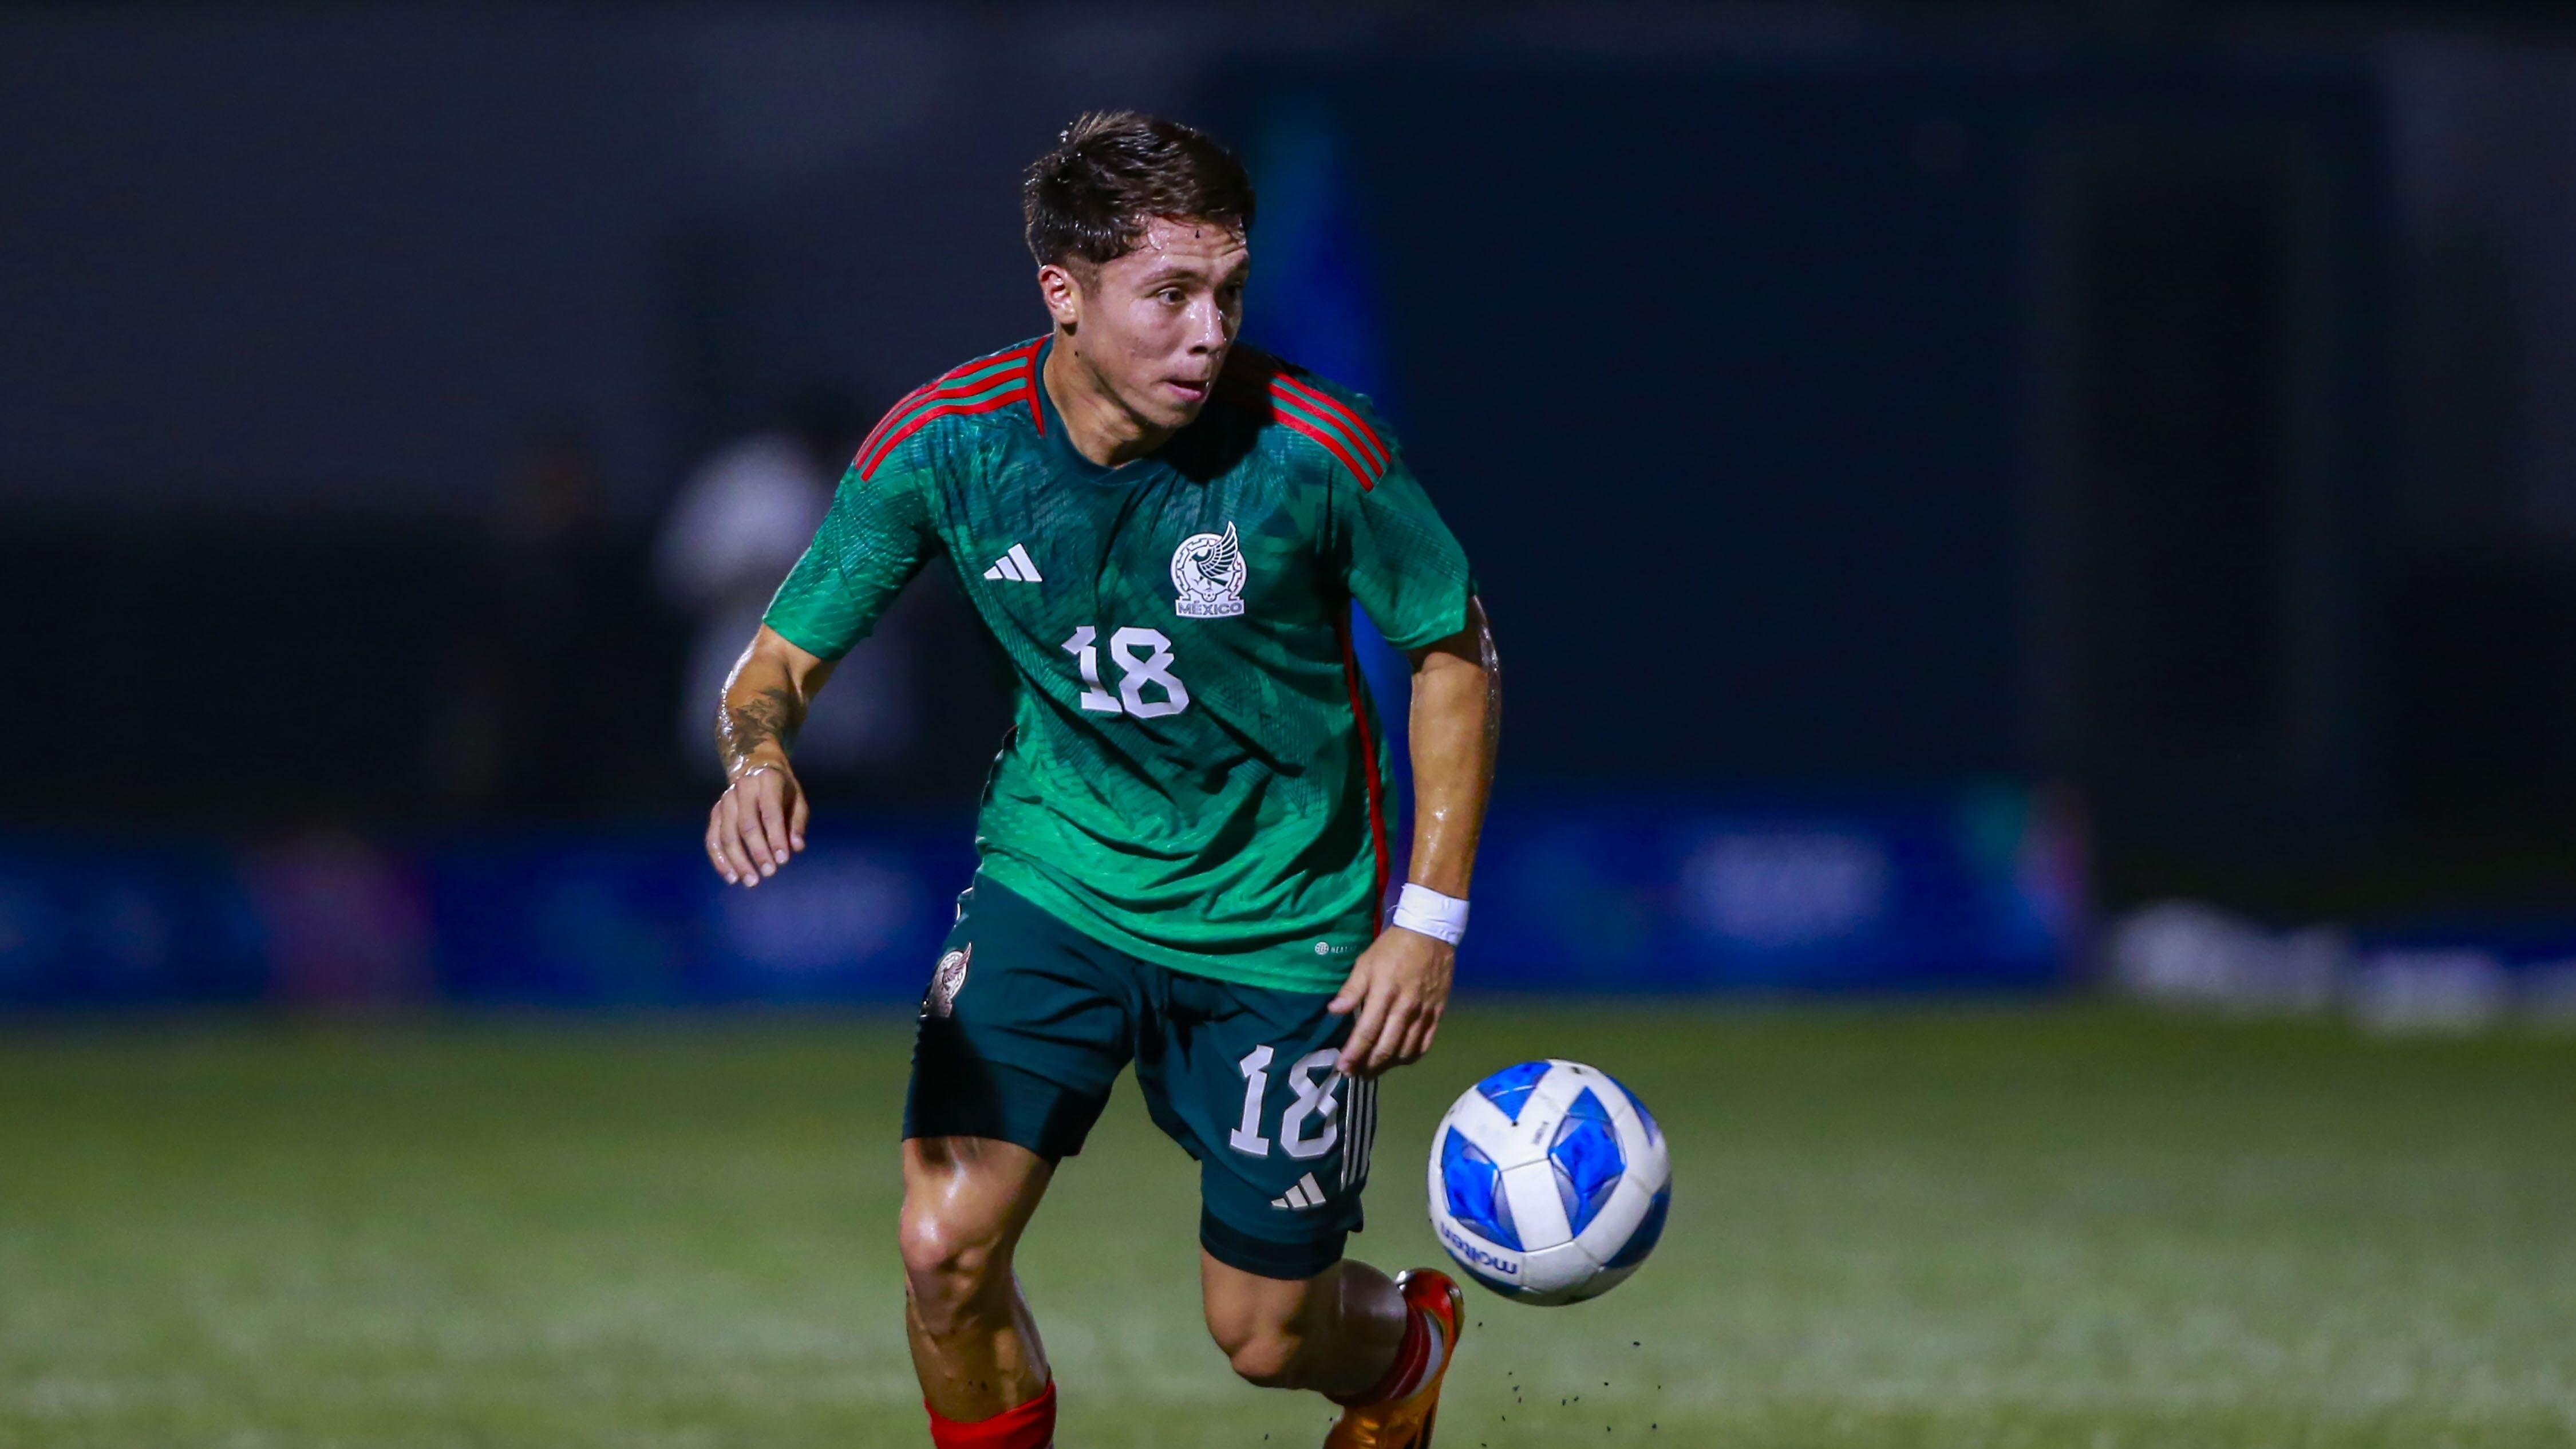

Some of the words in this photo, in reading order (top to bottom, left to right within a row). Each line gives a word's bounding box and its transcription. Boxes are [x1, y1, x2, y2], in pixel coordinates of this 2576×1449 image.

[1061, 626, 1190, 718] 18
[1230, 1045, 1342, 1158] 18
[1440, 1221, 1518, 1274] molten
